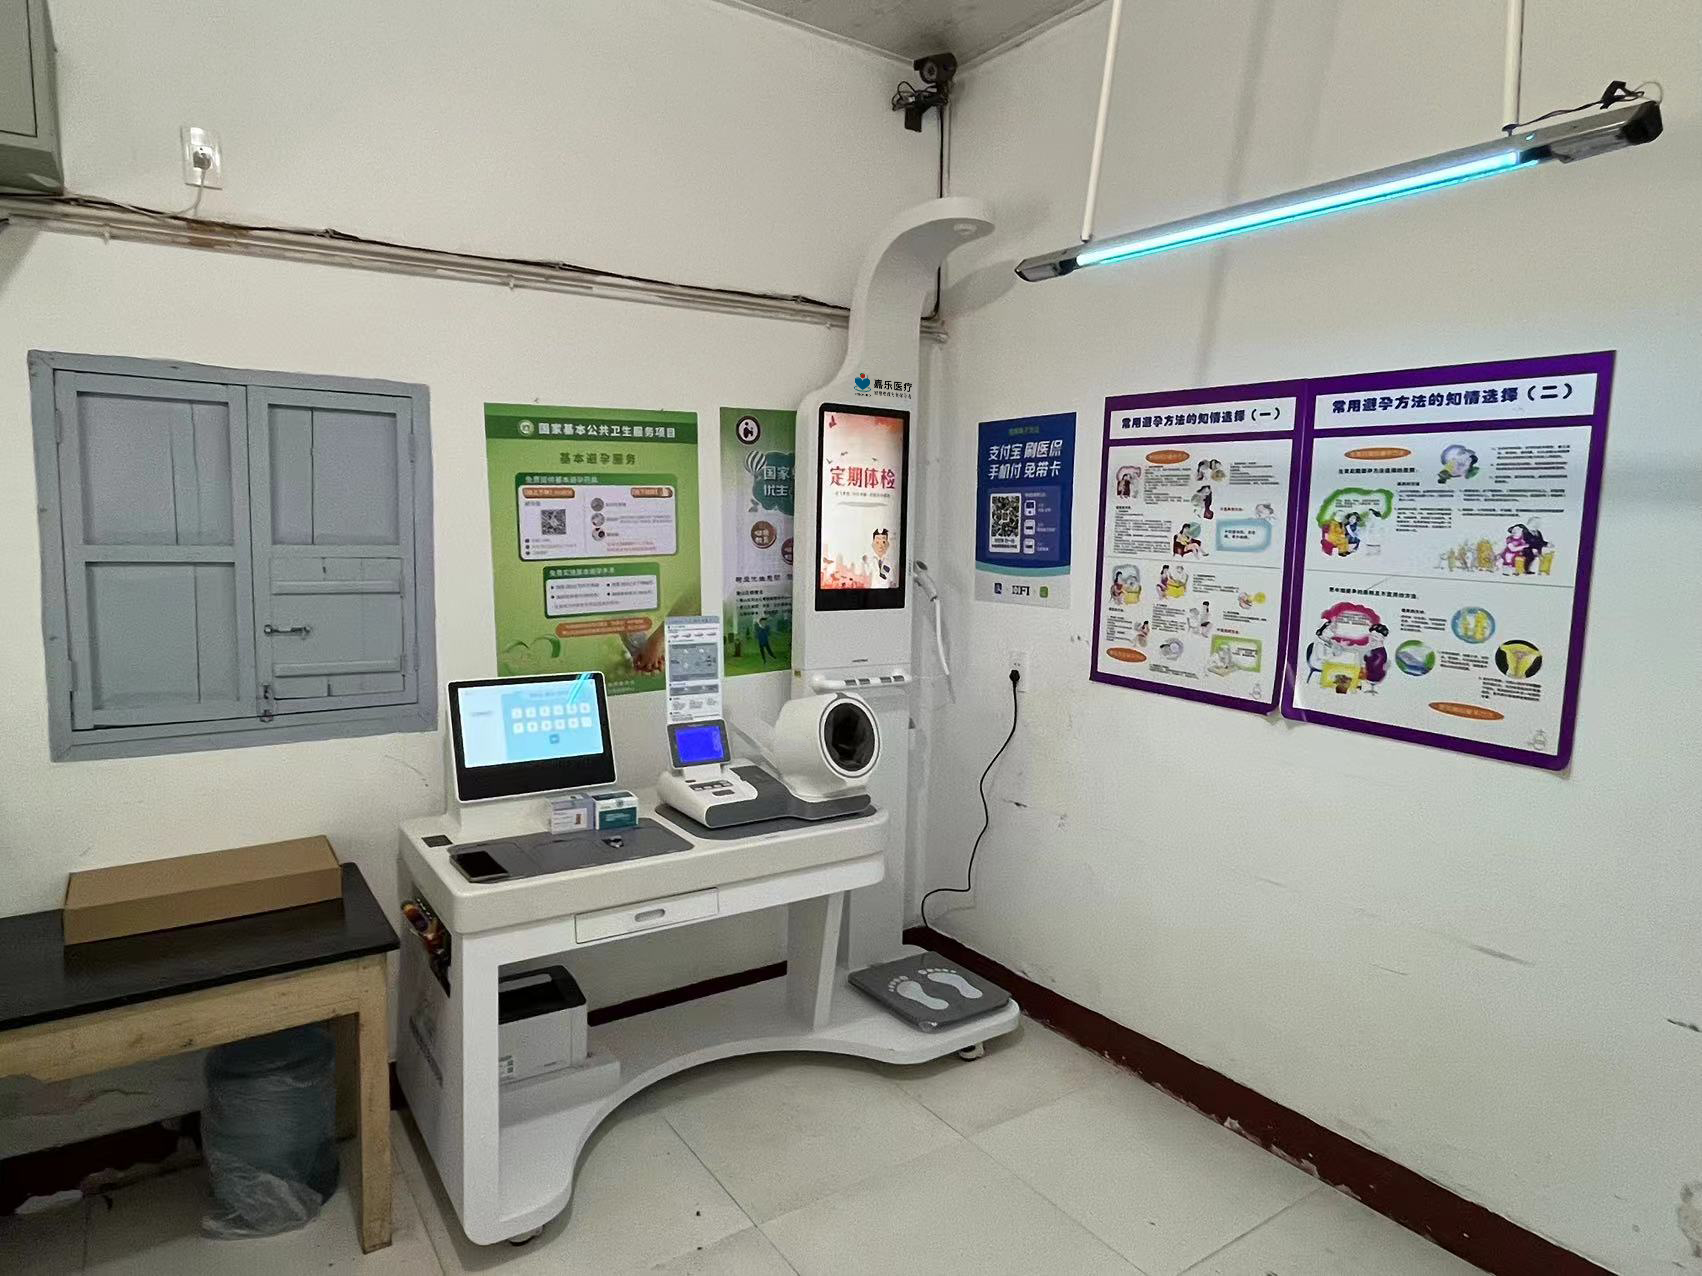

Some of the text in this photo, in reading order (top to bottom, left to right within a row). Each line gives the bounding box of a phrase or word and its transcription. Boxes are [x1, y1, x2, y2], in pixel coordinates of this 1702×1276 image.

[873, 379, 912, 392] 嘉乐医疗
[538, 422, 676, 439] 国家基本公共卫生服务项目
[559, 452, 636, 465] 基本避孕服务
[988, 440, 1063, 461] 支付宝 刷医保
[763, 465, 790, 480] 国家
[829, 465, 896, 490] 定期体检
[988, 461, 1062, 480] 手机付 免带卡
